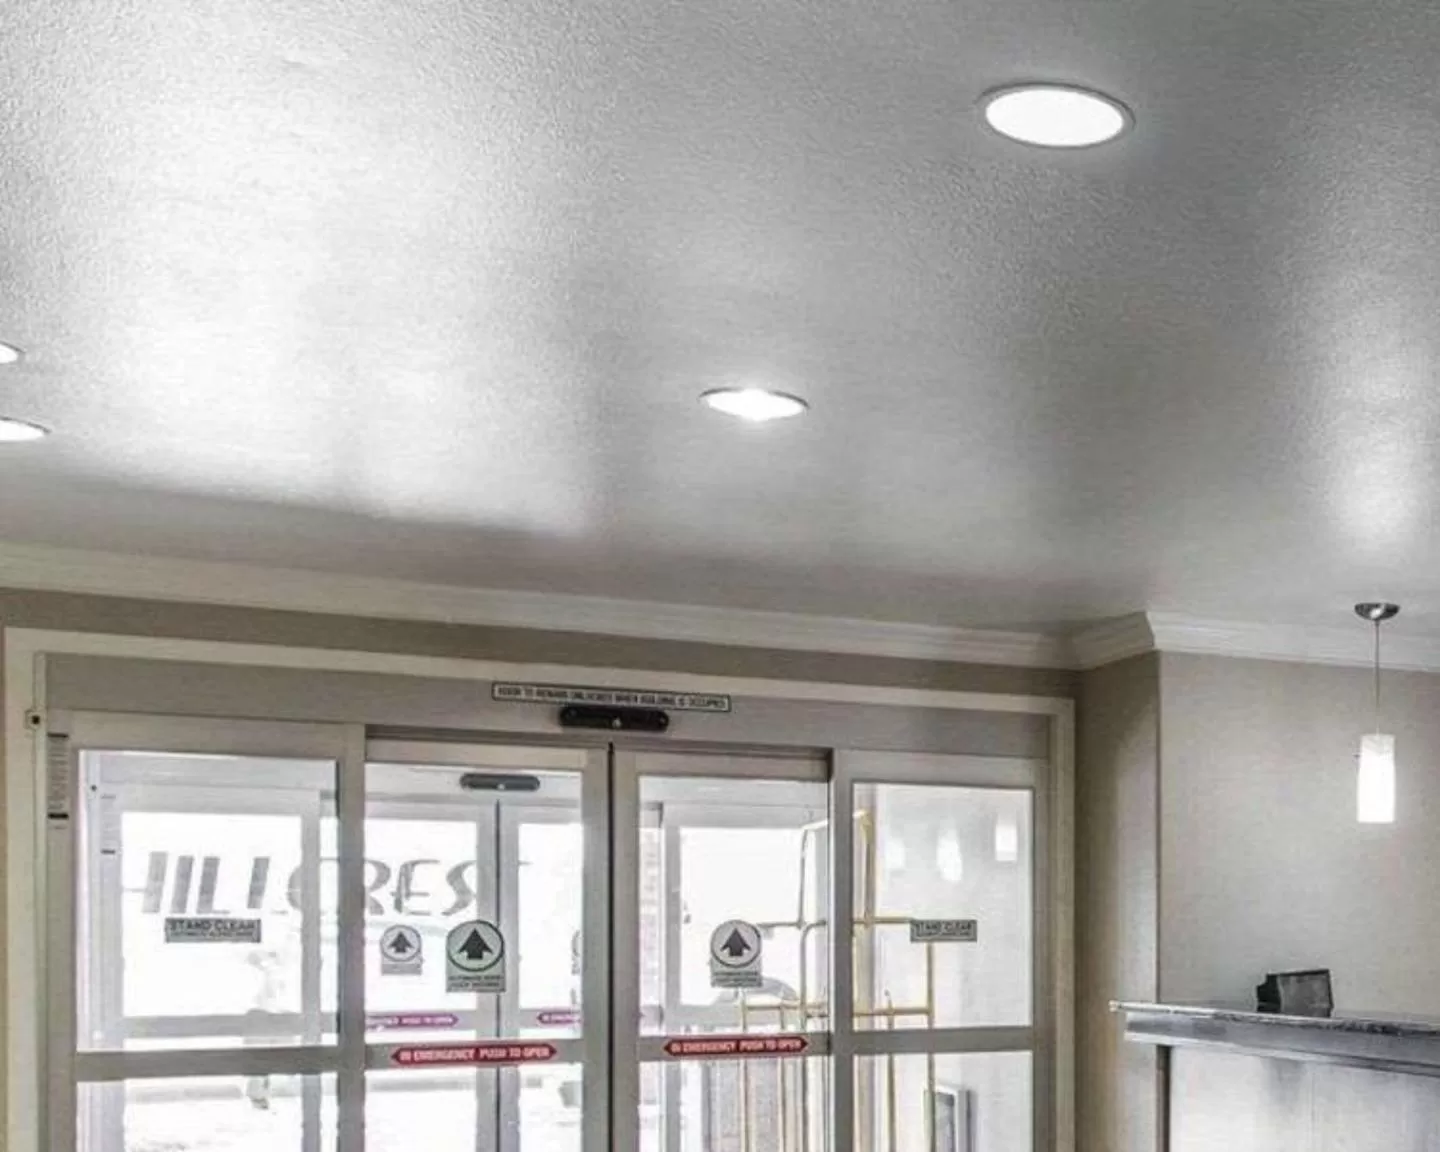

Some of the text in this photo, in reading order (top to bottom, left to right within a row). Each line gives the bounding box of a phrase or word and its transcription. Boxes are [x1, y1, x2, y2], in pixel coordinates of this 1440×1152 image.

[413, 1049, 475, 1061] EMERGENCY
[479, 1048, 507, 1060] PUSH
[509, 1047, 521, 1058] TO
[523, 1046, 550, 1058] OPEN
